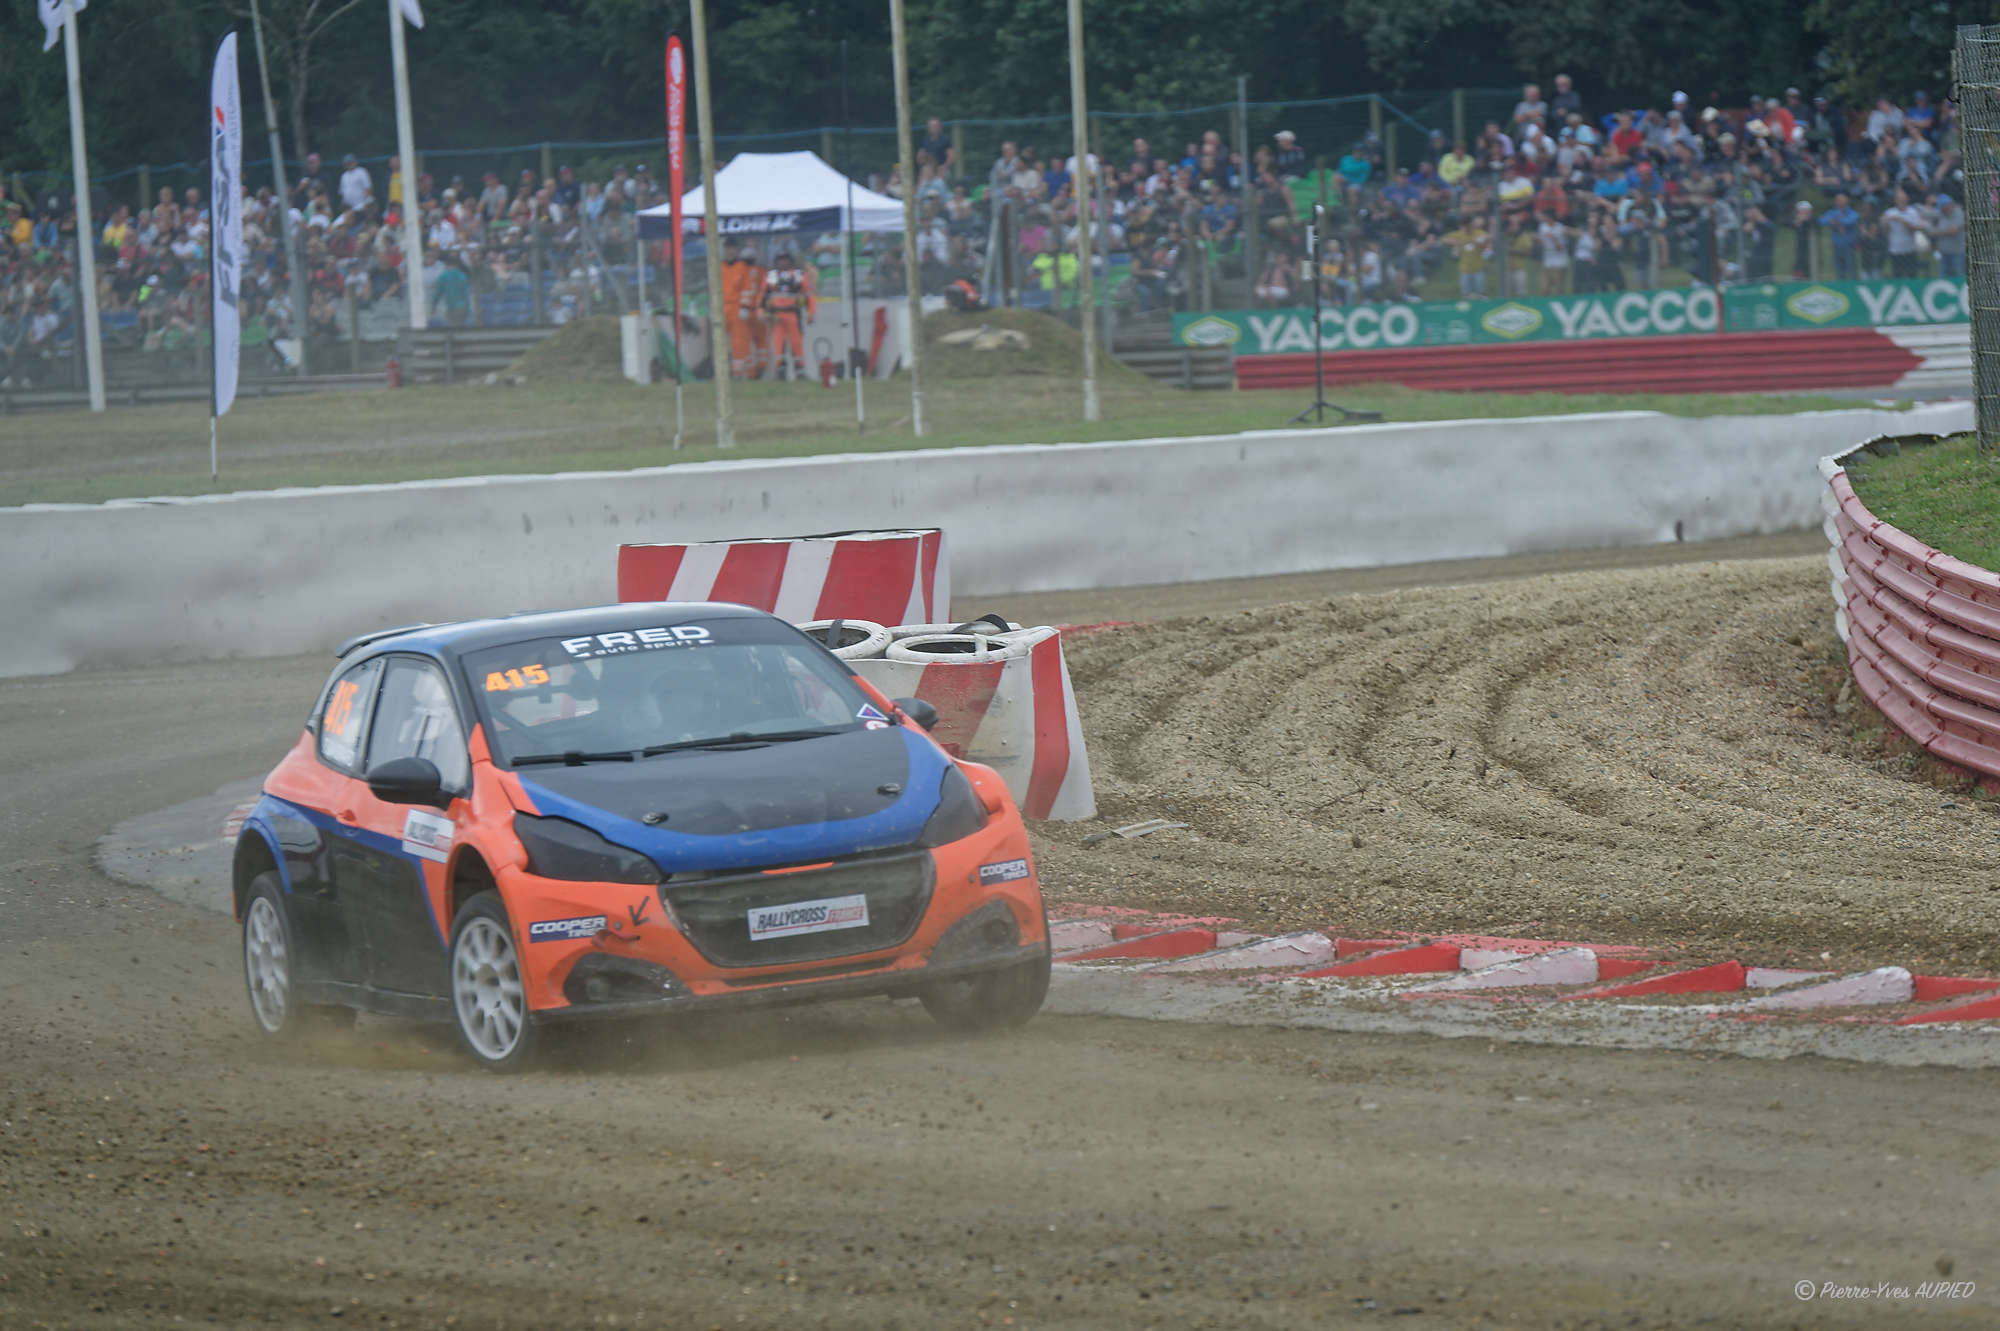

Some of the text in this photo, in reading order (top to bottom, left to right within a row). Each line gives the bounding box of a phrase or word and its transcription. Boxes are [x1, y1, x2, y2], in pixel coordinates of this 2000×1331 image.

[1549, 290, 1719, 337] YACCO
[1856, 279, 1970, 323] YAC
[1249, 305, 1418, 351] YACCO
[560, 626, 710, 654] FRED
[594, 639, 692, 656] auto sport
[485, 664, 550, 692] 415
[979, 859, 1026, 877] COOPER
[530, 916, 607, 934] COOPER
[757, 906, 827, 930] RALLYCROSS
